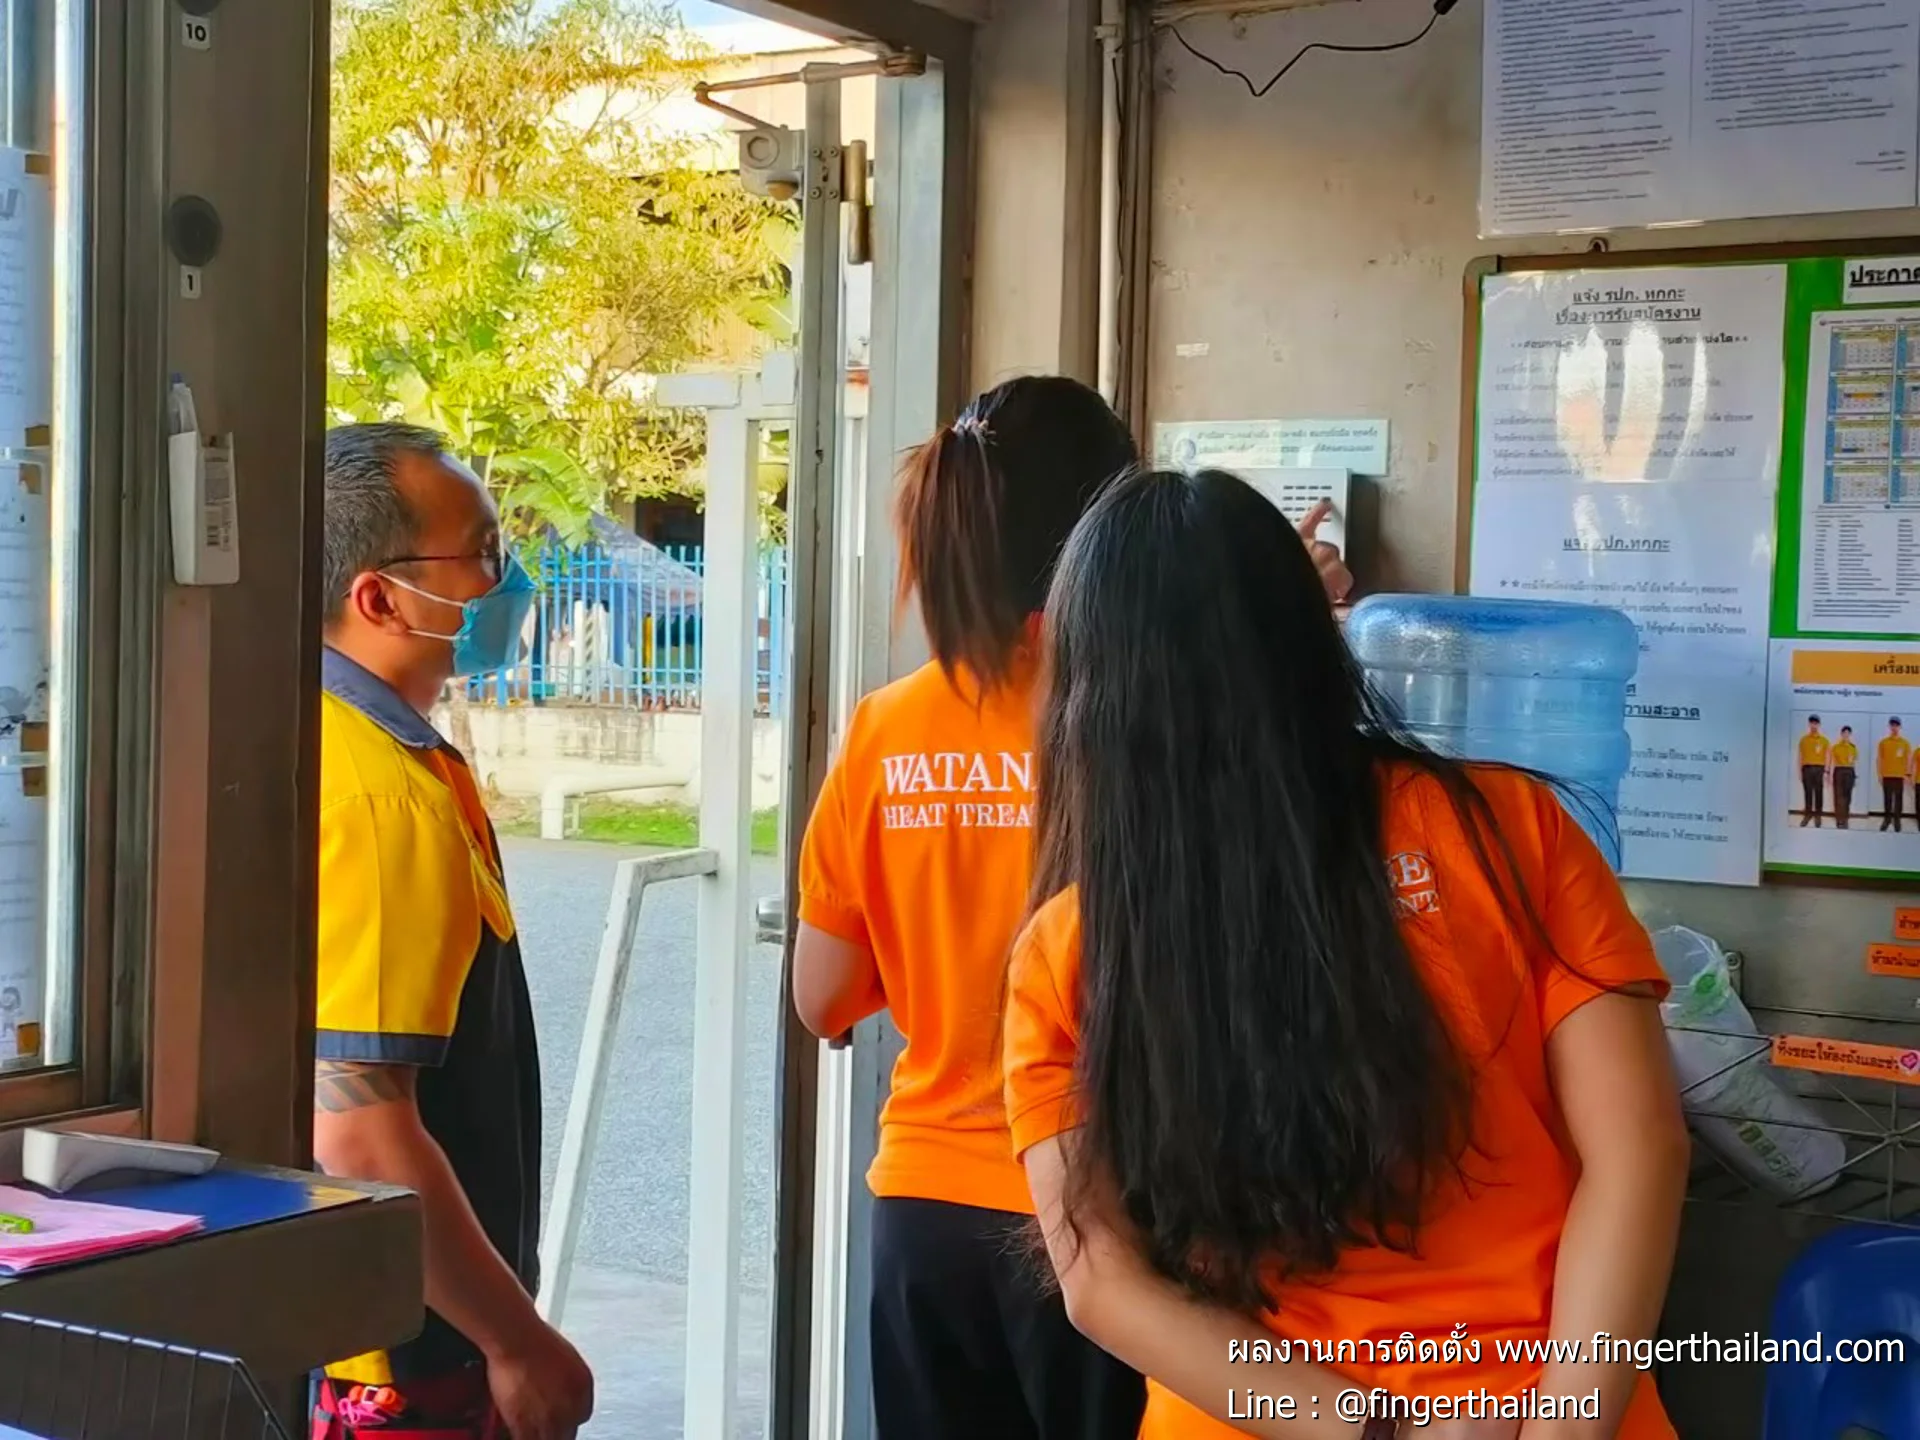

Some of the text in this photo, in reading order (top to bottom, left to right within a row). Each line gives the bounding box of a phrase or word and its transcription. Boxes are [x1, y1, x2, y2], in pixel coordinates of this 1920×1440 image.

[186, 23, 206, 41] 10
[187, 274, 193, 291] 1
[883, 803, 947, 829] HEAT
